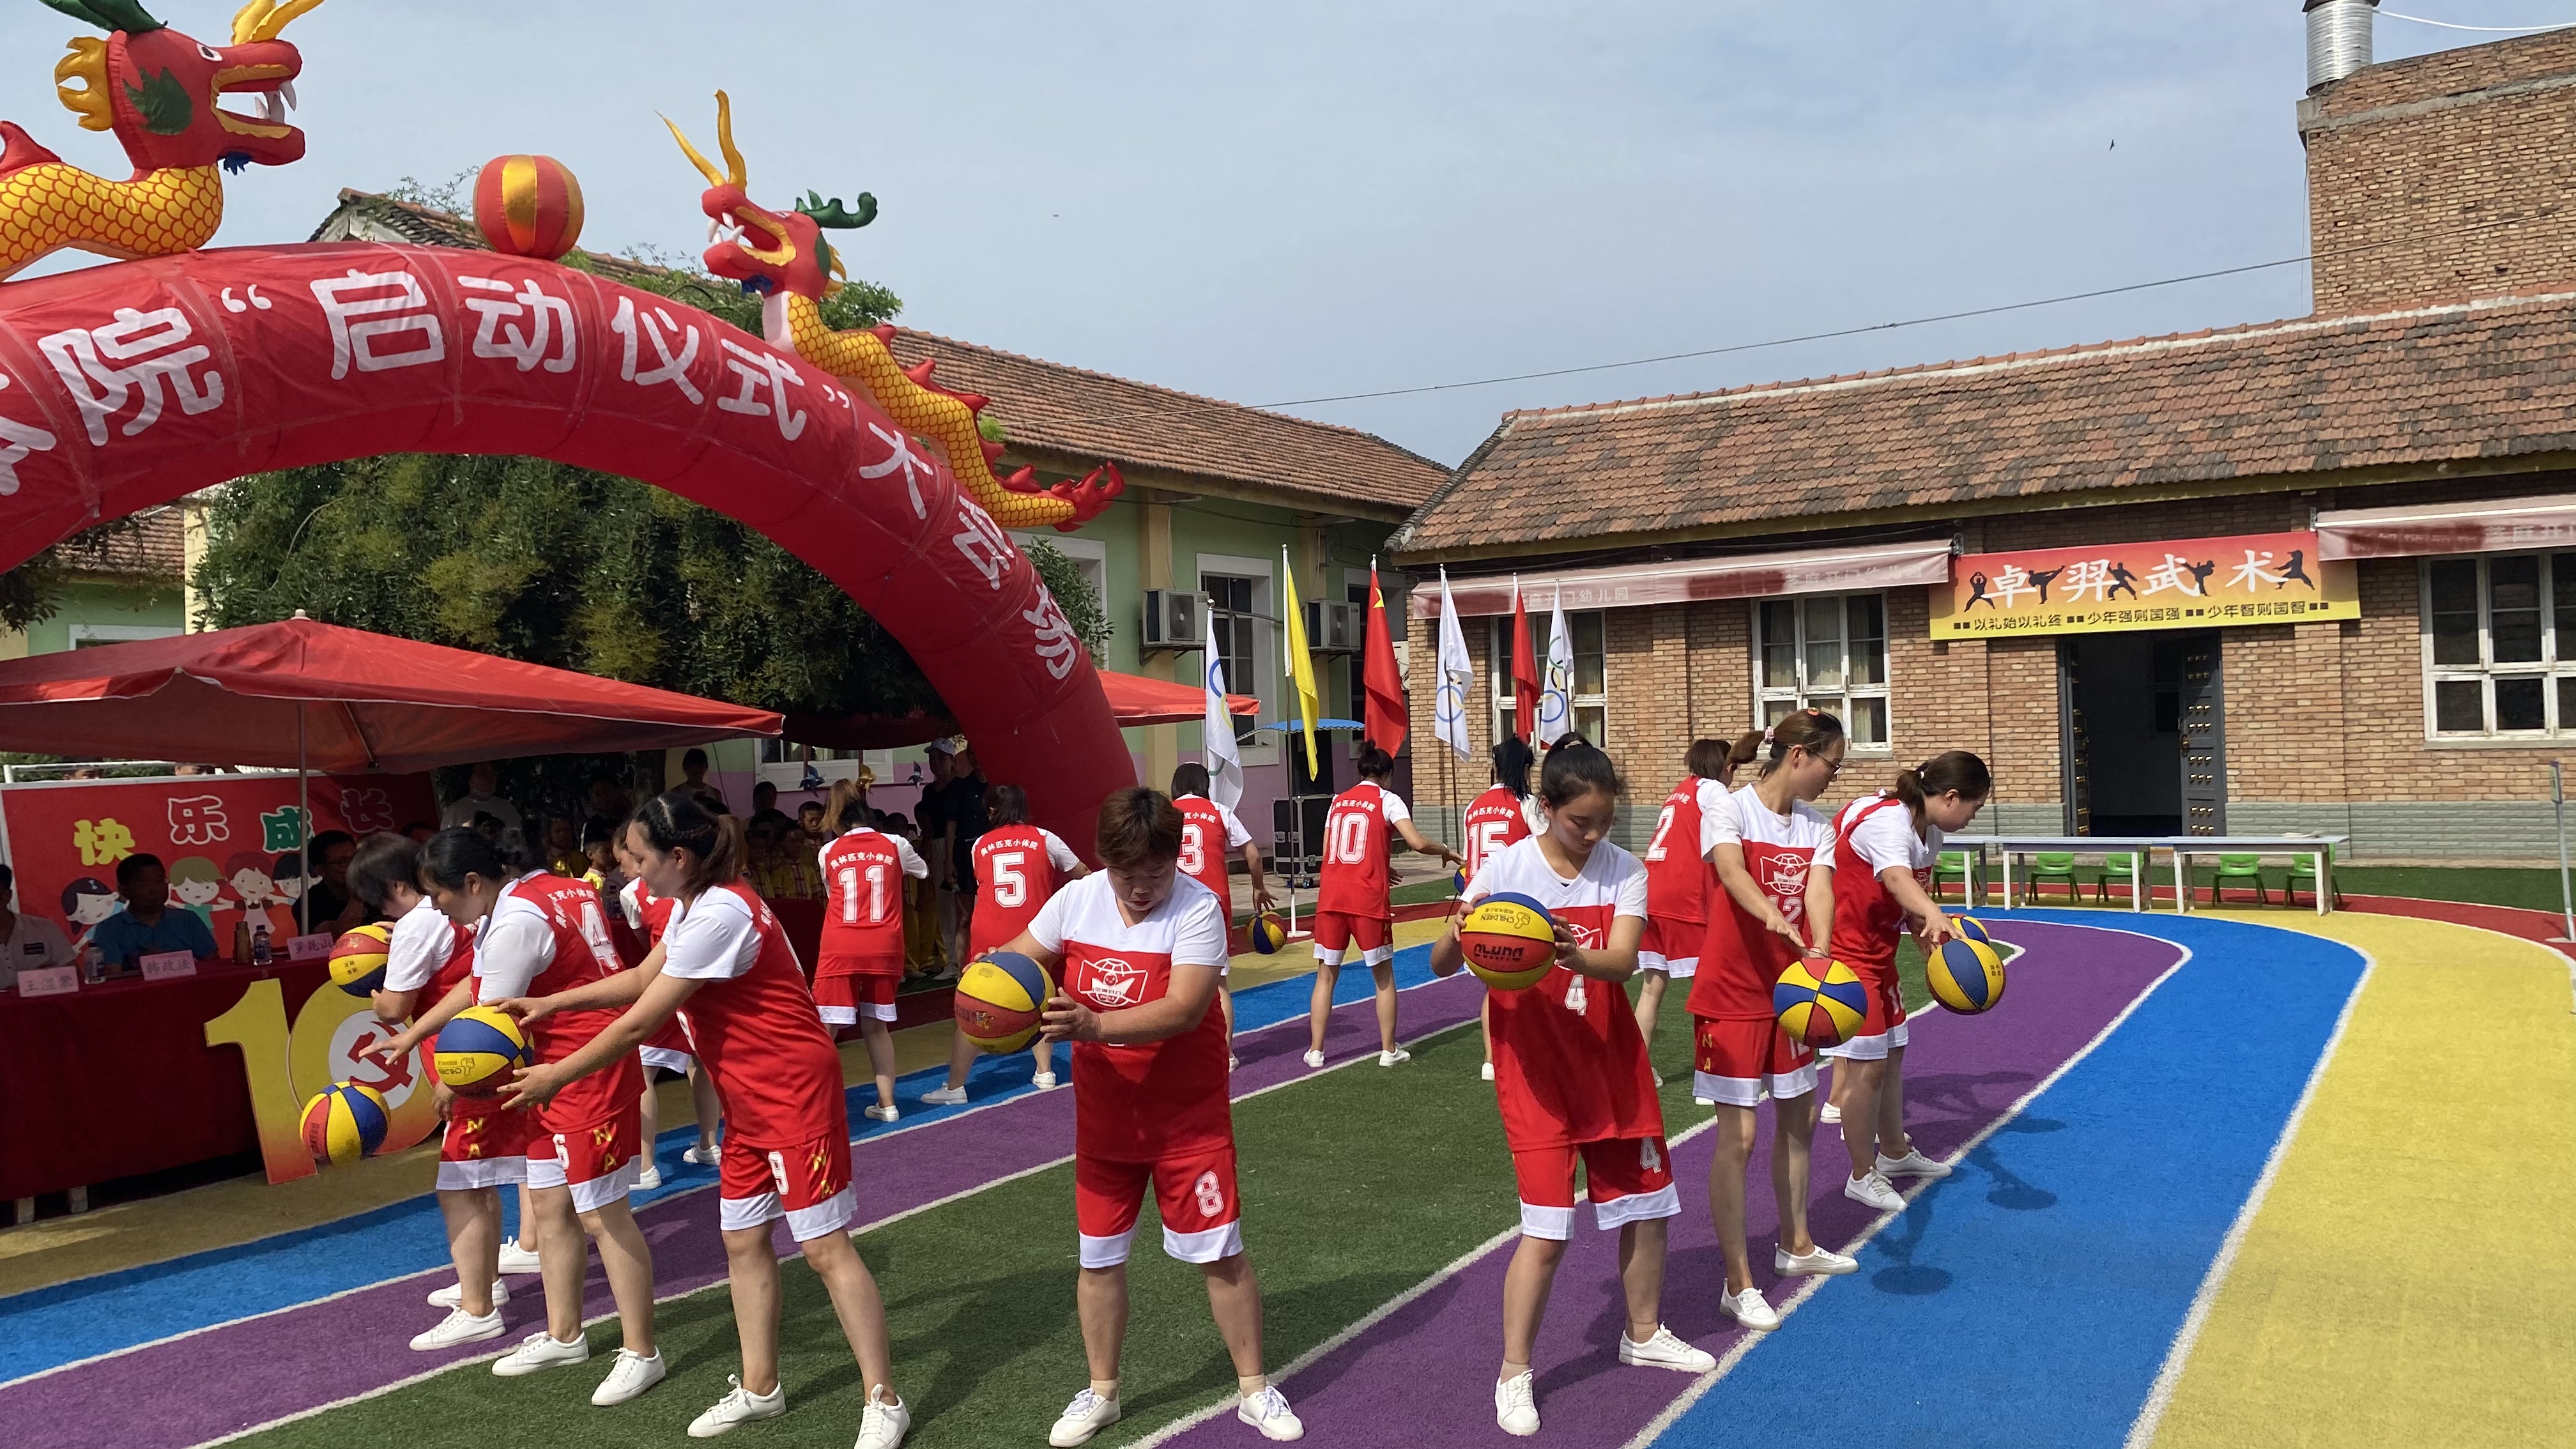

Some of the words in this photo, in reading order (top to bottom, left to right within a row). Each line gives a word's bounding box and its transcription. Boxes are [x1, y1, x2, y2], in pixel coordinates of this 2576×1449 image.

[1523, 586, 1629, 607] 麻开门幼儿园
[1981, 549, 2289, 608] 卓羿武术
[1974, 614, 2063, 631] 以礼始以礼终
[2087, 608, 2180, 625] 少年强则国强
[2207, 601, 2306, 618] 少年智则国智
[73, 788, 395, 866] 快乐成长
[980, 838, 1039, 857] 奥林匹克小体院
[1328, 812, 1369, 864] 10
[1468, 820, 1510, 877] 15
[1645, 804, 1676, 861] 2
[830, 851, 894, 870] 奥林匹克小体院
[1176, 824, 1204, 875] 3
[838, 864, 884, 924] 11
[992, 851, 1027, 908] 5
[1480, 914, 1515, 924] CHILDREN
[1564, 974, 1588, 1016] 4
[552, 1133, 570, 1170] 6
[768, 1151, 789, 1195] 9
[1639, 1137, 1663, 1174] 4
[1194, 1170, 1225, 1217] 8
